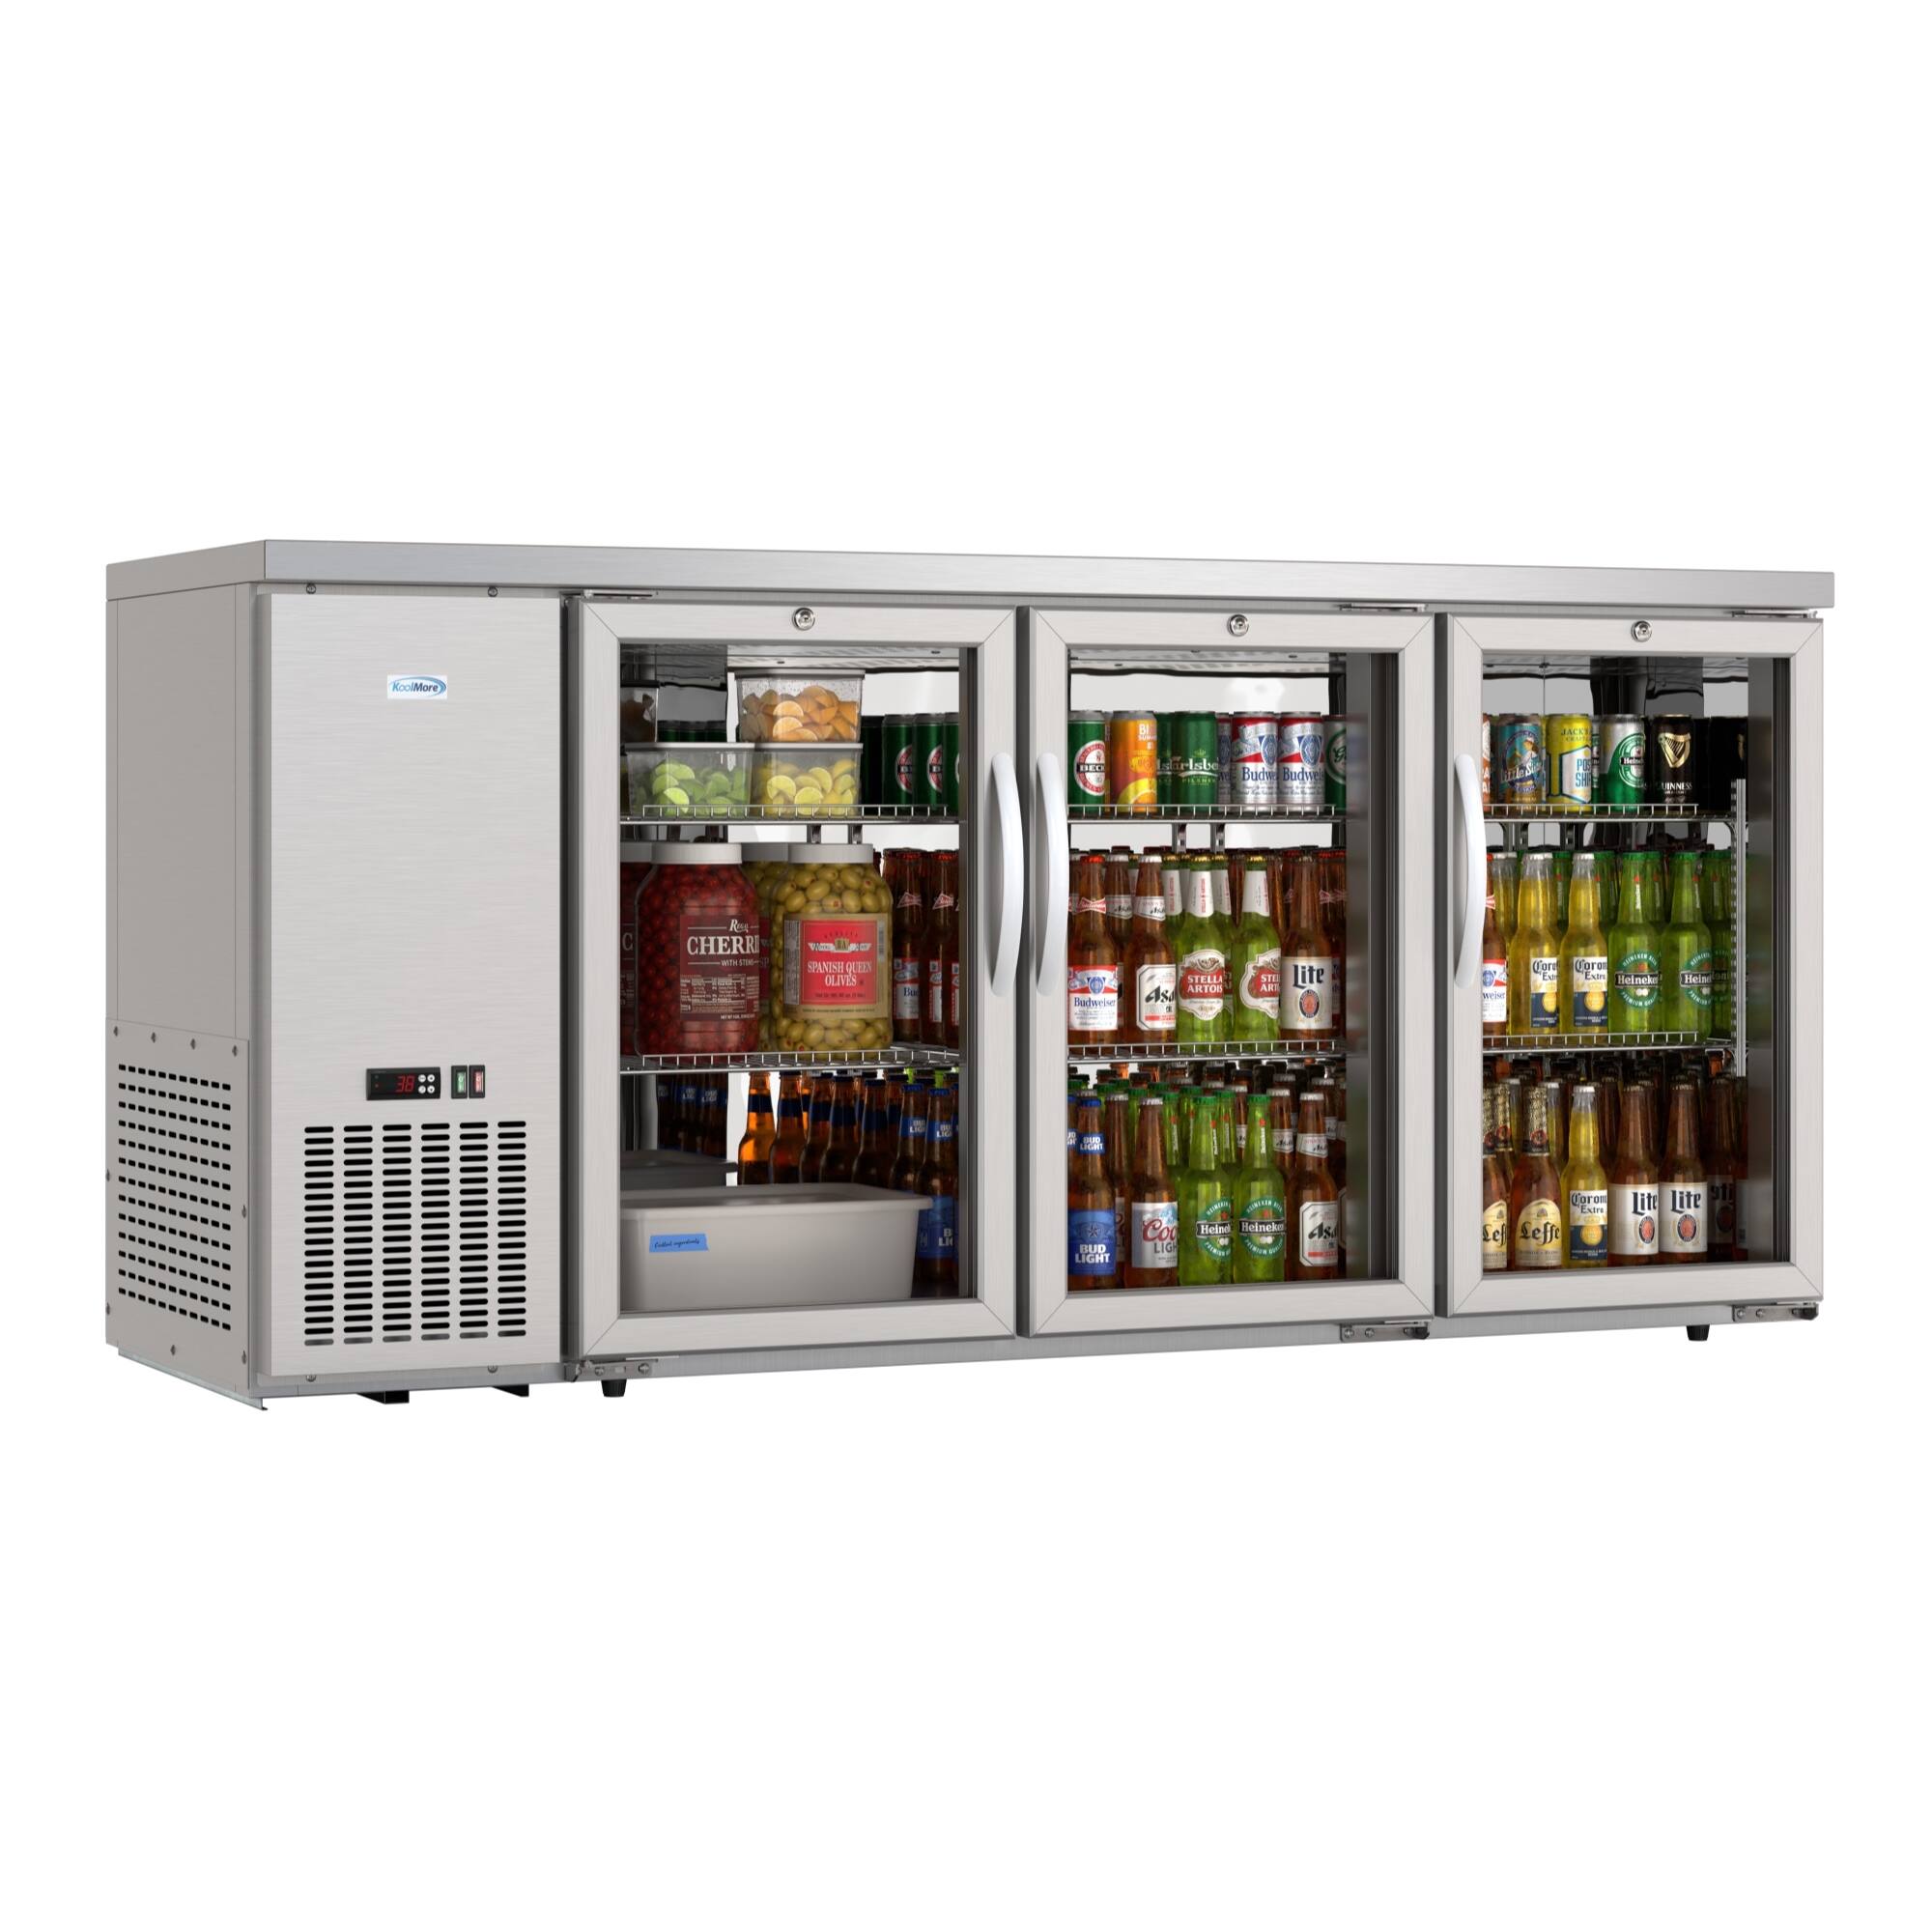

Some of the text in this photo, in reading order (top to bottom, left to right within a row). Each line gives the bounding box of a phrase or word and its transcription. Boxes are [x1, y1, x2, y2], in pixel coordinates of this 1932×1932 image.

[391, 682, 439, 693] KoolMore
[808, 961, 872, 978] SPANISH QUEEN
[824, 974, 858, 986] OLIVES
[1293, 964, 1325, 989] Lite
[1186, 983, 1223, 994] ARTOIS
[1073, 996, 1117, 1009] Budweiser
[1083, 1136, 1101, 1146] BUD
[1080, 1143, 1103, 1151] LIGHT
[1632, 1191, 1658, 1216] Lite
[1670, 1189, 1701, 1214] Lite
[1580, 1205, 1604, 1215] Extra
[1519, 1220, 1561, 1246] Leffe
[1079, 1243, 1107, 1254] BUD
[1075, 1253, 1111, 1264] LIGHT
